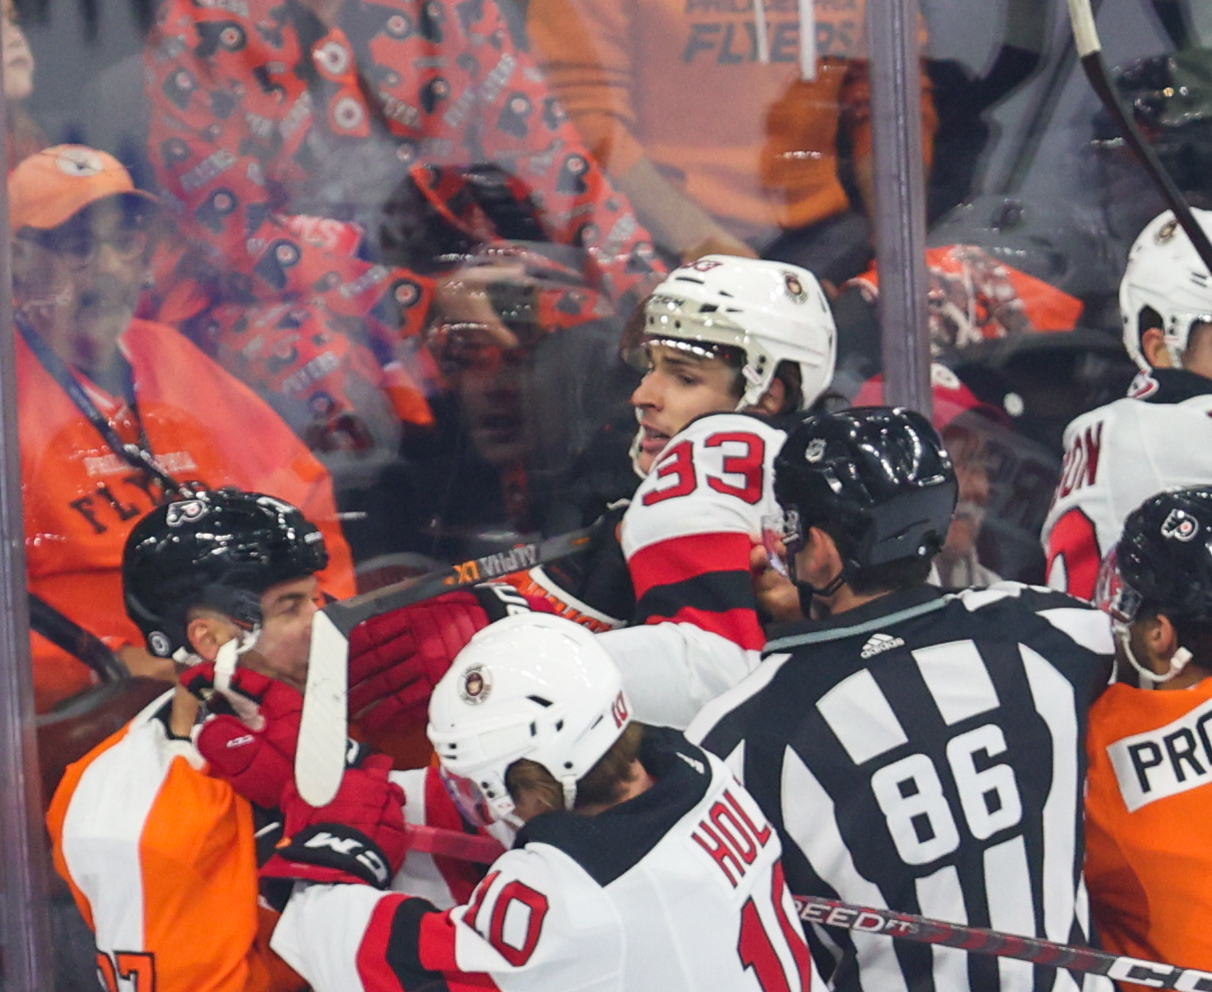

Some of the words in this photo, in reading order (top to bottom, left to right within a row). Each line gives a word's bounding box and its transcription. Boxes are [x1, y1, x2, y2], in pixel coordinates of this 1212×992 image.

[641, 430, 766, 506] 33
[860, 637, 906, 659] adidas
[690, 787, 773, 890] HOL
[870, 723, 1023, 866] 86
